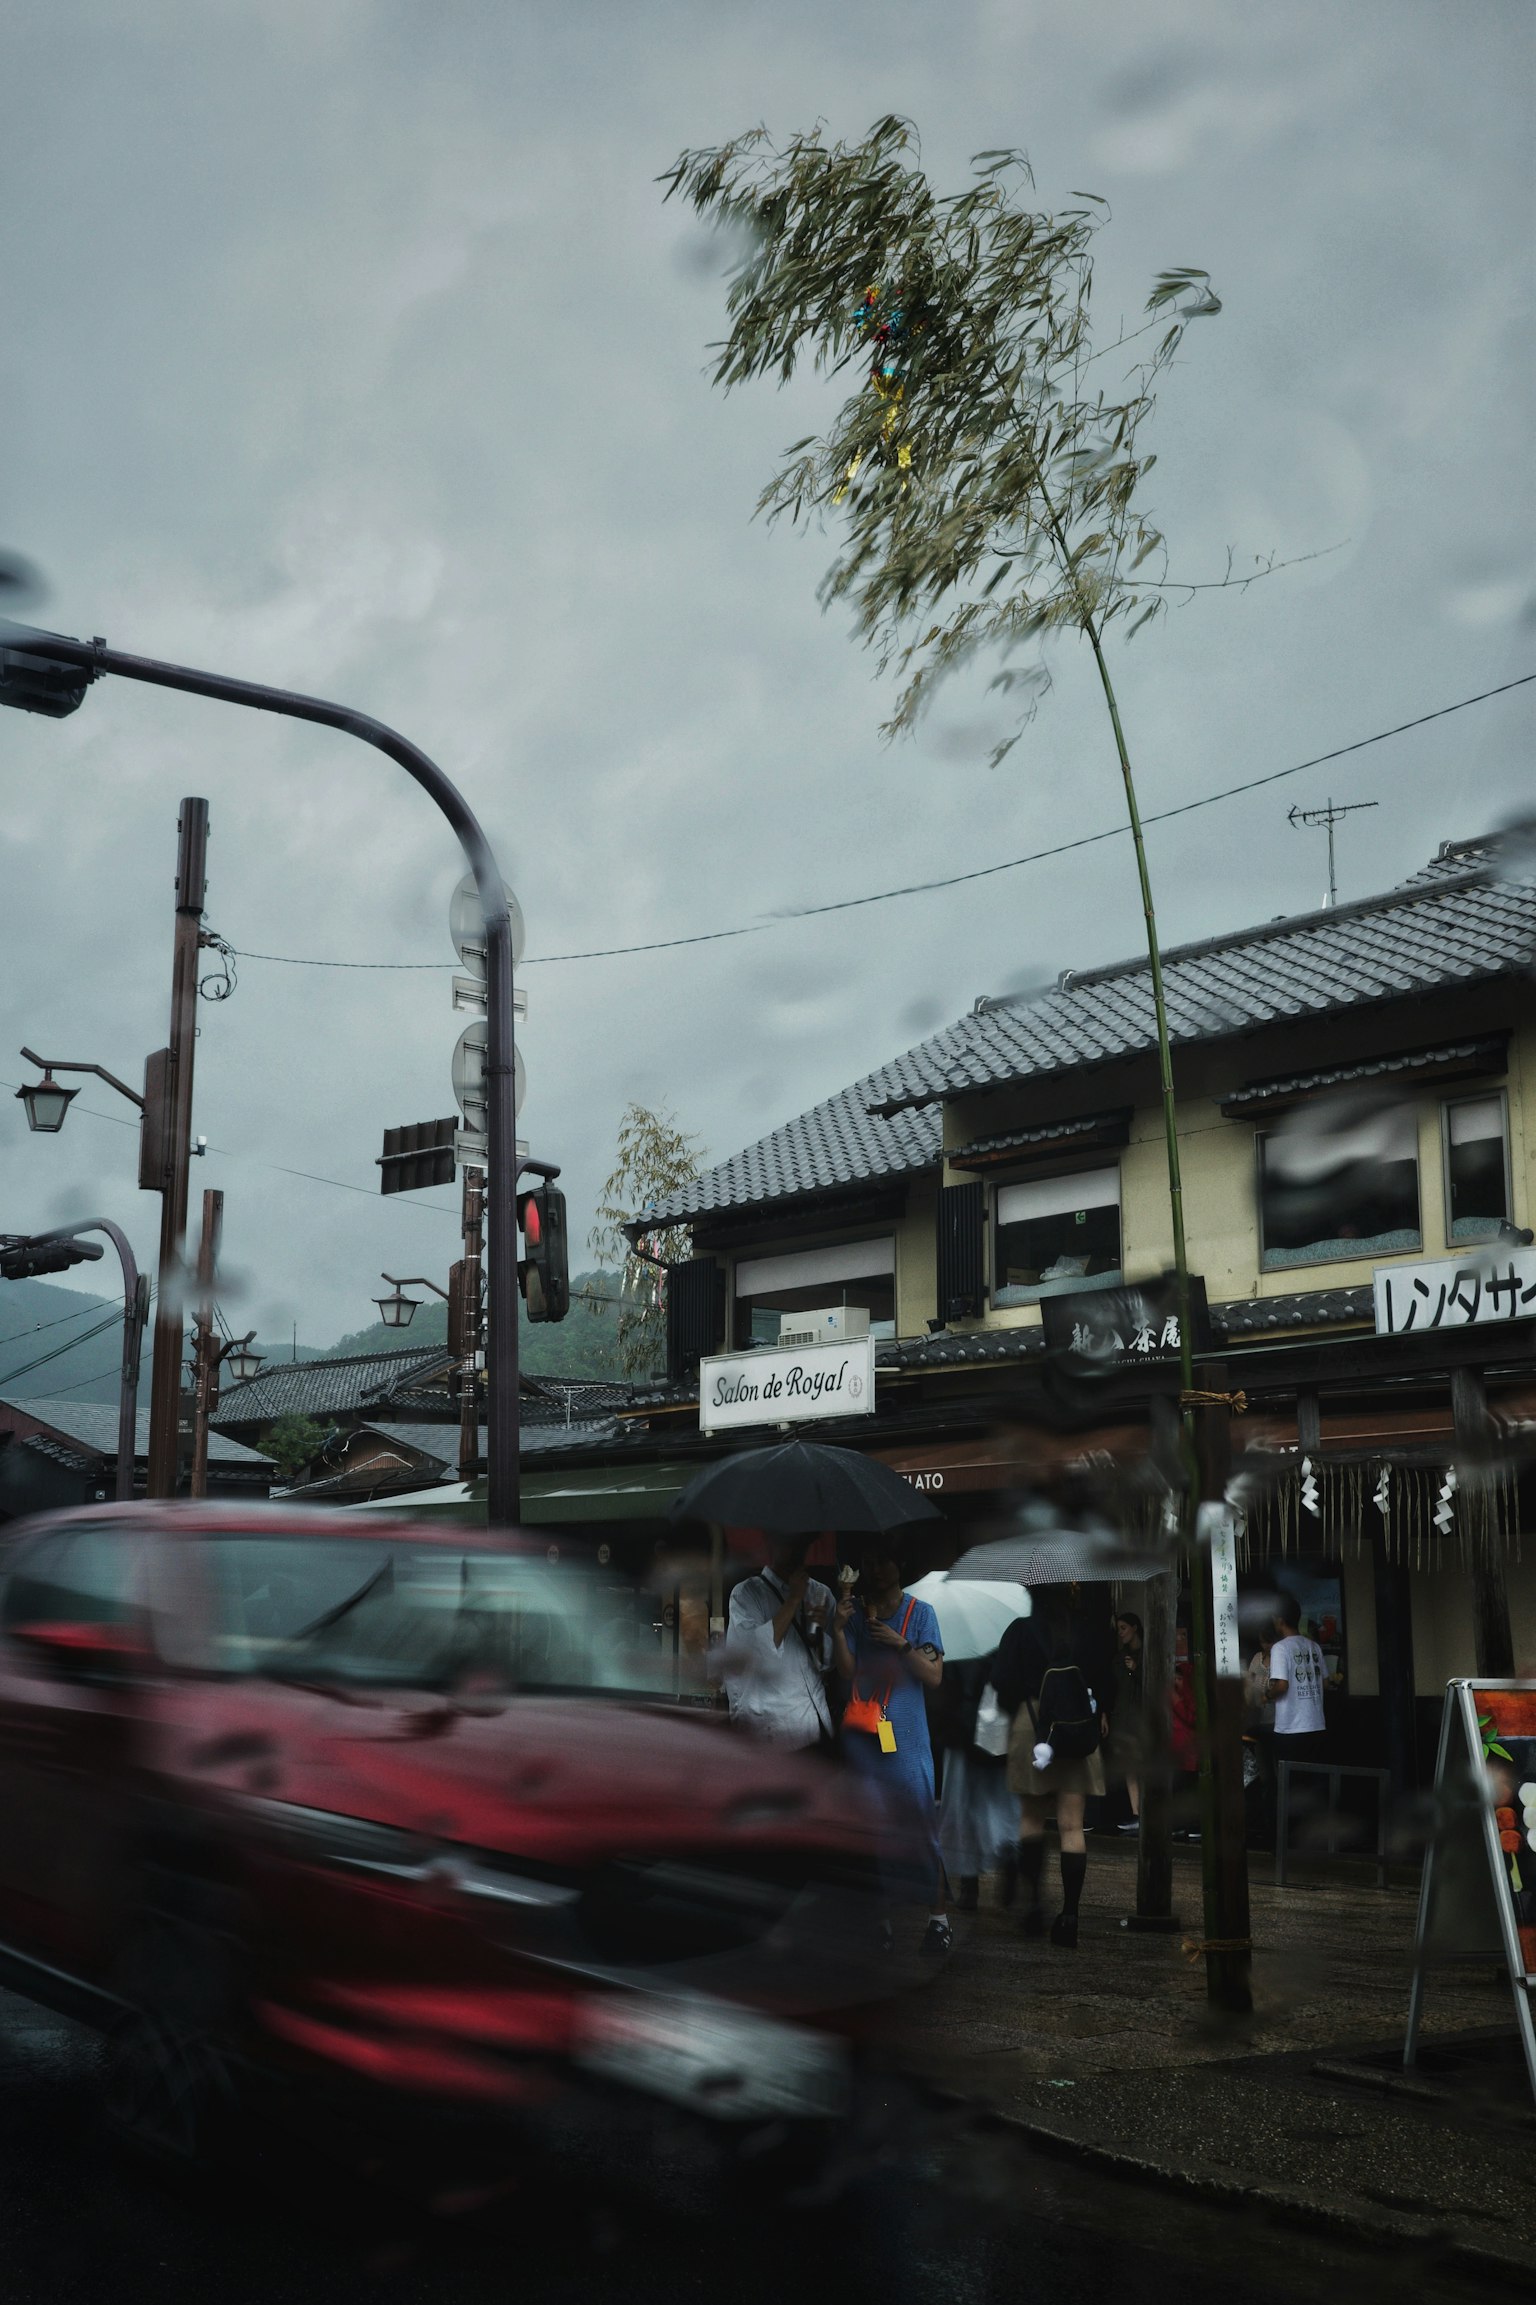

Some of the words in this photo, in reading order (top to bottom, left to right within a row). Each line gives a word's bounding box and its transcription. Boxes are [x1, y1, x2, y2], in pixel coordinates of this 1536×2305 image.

[712, 1374, 759, 1407] Salon
[763, 1373, 783, 1400] de
[785, 1360, 849, 1401] Royal
[902, 1472, 944, 1490] ATO
